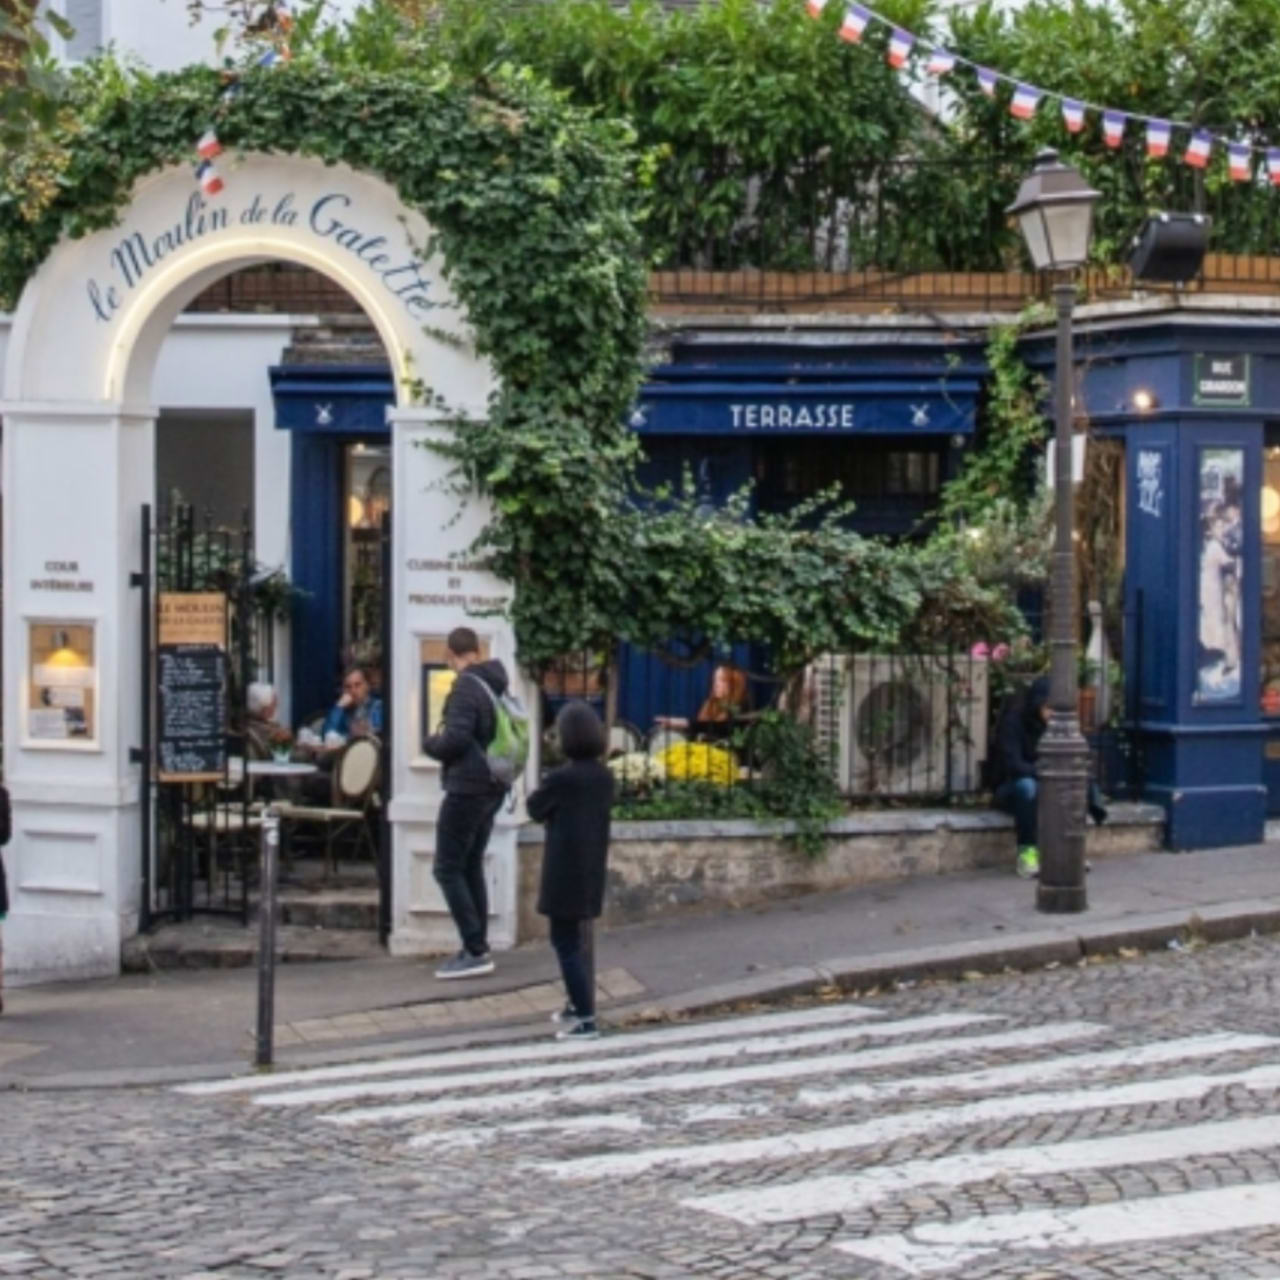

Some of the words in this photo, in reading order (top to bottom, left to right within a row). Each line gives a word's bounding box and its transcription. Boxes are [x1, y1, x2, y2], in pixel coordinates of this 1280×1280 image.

[86, 278, 119, 322] le
[110, 190, 228, 289] Moulin
[239, 194, 268, 225] de
[272, 191, 299, 227] la
[310, 193, 436, 321] Galette
[729, 404, 855, 428] TERRASSE
